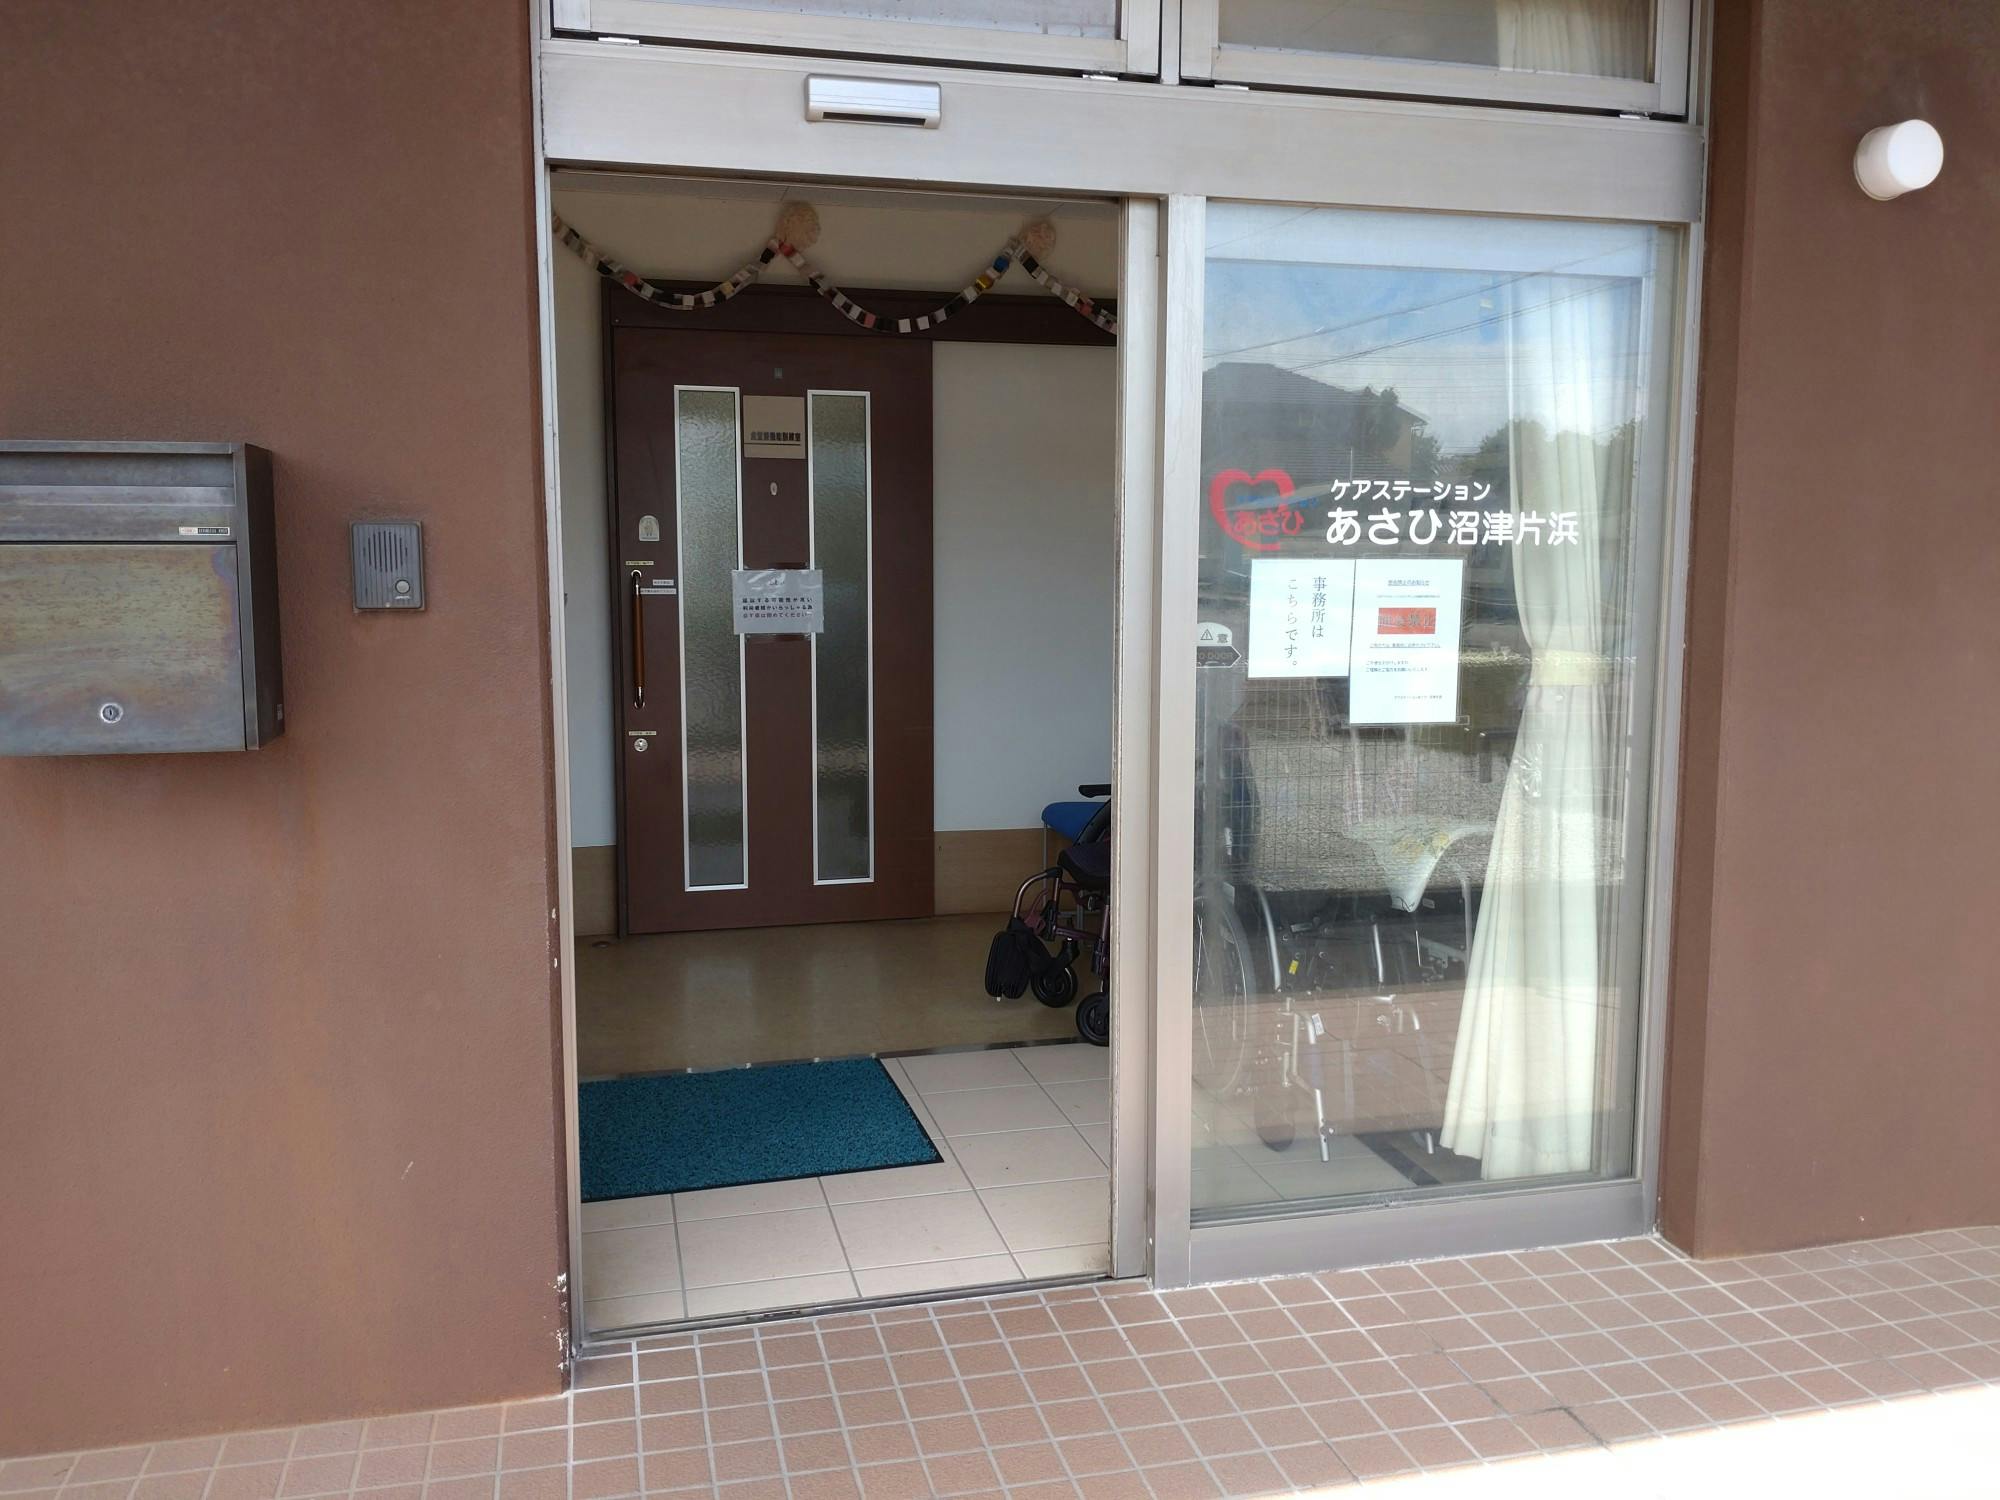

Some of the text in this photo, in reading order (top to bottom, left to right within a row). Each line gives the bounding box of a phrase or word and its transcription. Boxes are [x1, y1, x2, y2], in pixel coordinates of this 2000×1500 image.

[1330, 479, 1491, 501] ケアステーション
[1326, 507, 1579, 546] あさひ沼津片浜
[1284, 579, 1298, 666] こちらです。
[1312, 576, 1327, 638] 事務所は
